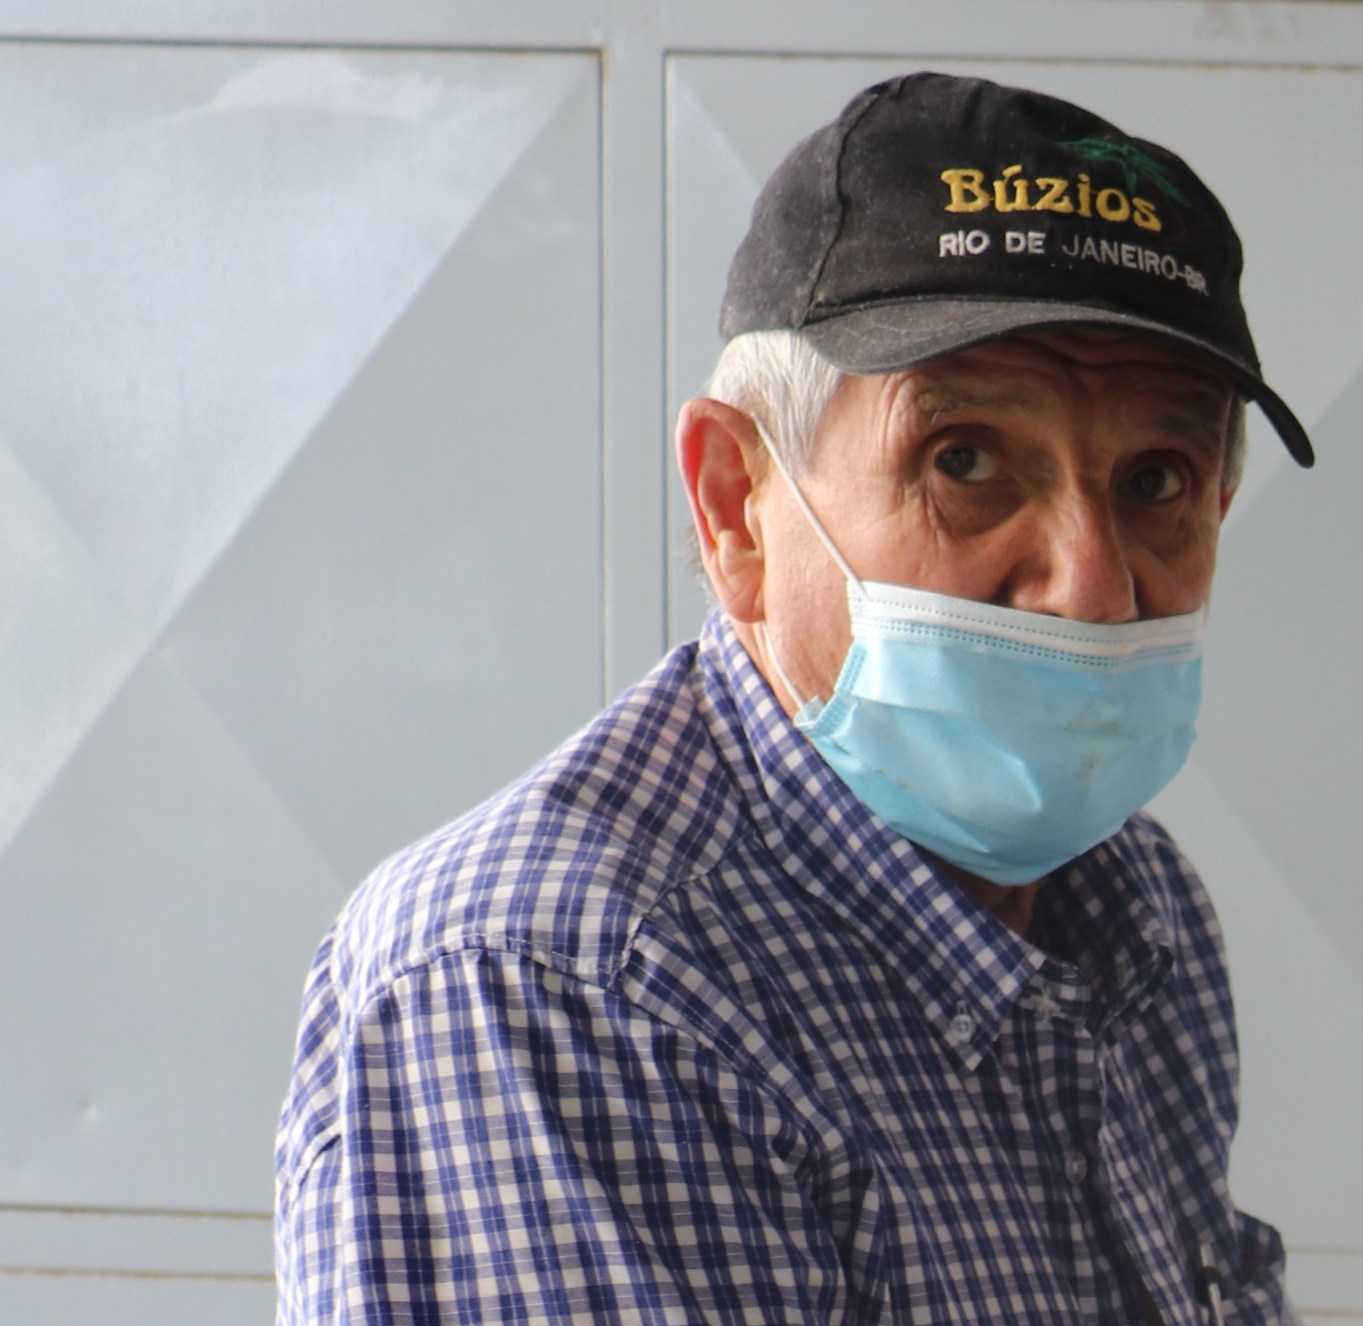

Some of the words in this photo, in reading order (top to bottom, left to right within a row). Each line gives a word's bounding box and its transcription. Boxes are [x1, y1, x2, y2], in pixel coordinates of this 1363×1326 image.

[940, 164, 1162, 232] Búzios
[938, 229, 990, 258] RIO
[1004, 231, 1046, 255] DE
[1062, 233, 1210, 297] JANEIRO-BR
